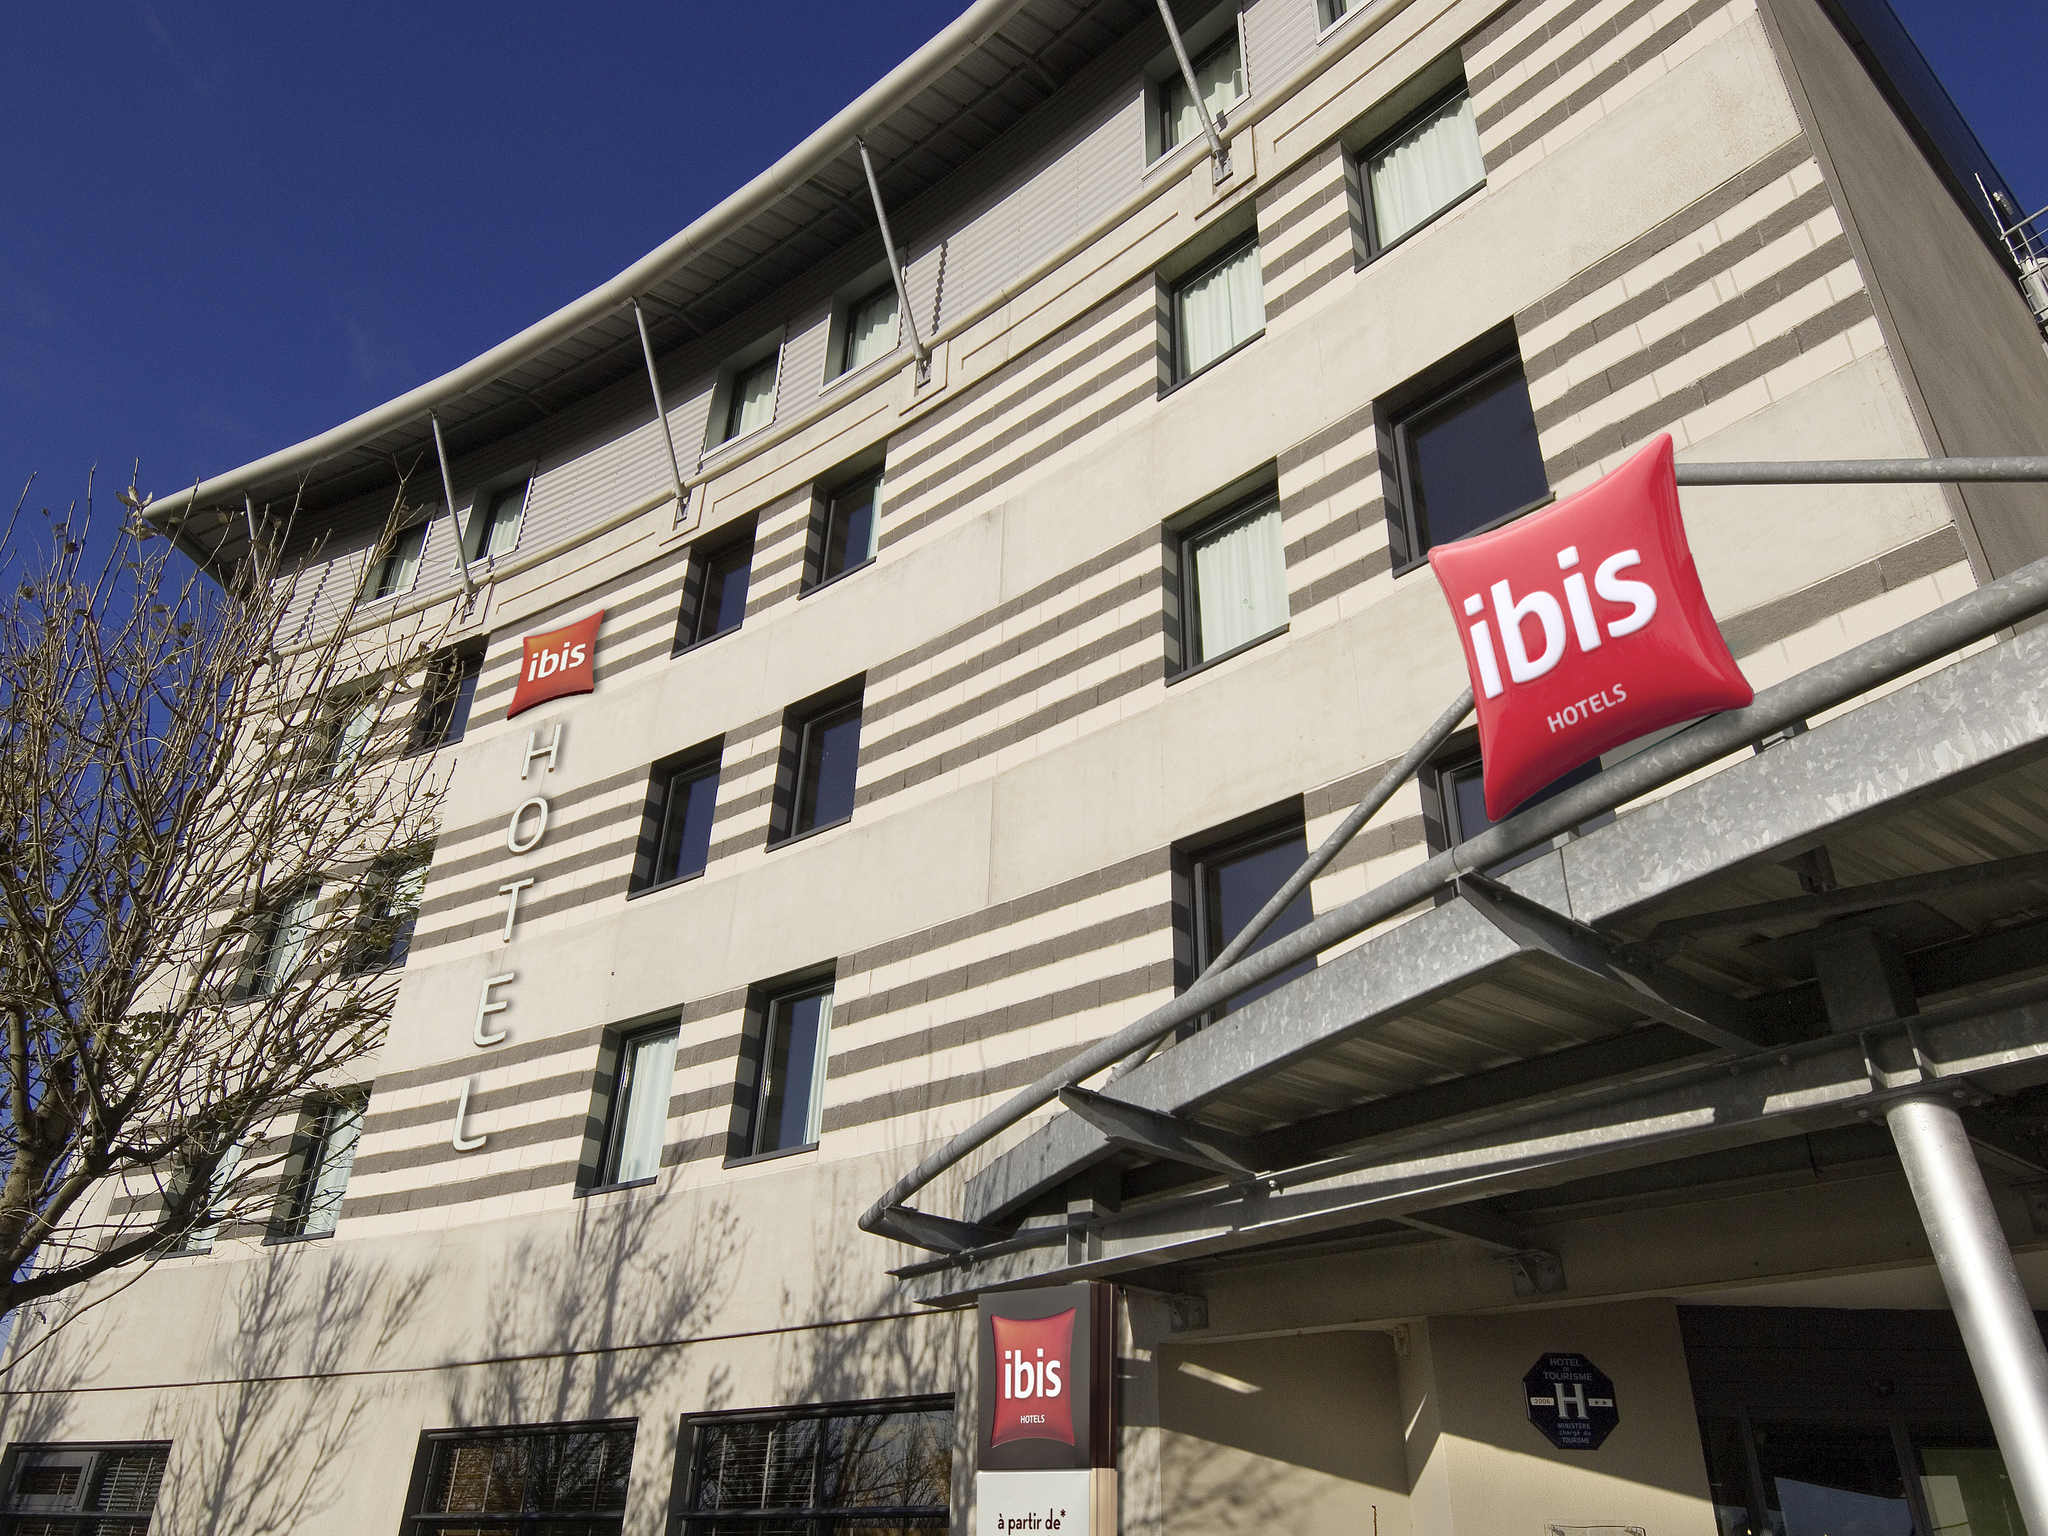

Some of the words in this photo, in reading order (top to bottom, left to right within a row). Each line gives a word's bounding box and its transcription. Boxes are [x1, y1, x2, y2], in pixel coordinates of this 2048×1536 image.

[1463, 545, 1658, 699] ibis
[527, 639, 588, 683] ibis
[1547, 683, 1627, 734] HOTELS
[451, 721, 564, 1152] HOTEL
[1004, 1348, 1062, 1399] ibis
[1543, 1371, 1593, 1381] TOURISME
[1020, 1414, 1045, 1424] HOTELS
[1553, 1382, 1590, 1420] H
[998, 1513, 1005, 1529] à
[1008, 1512, 1042, 1535] partir
